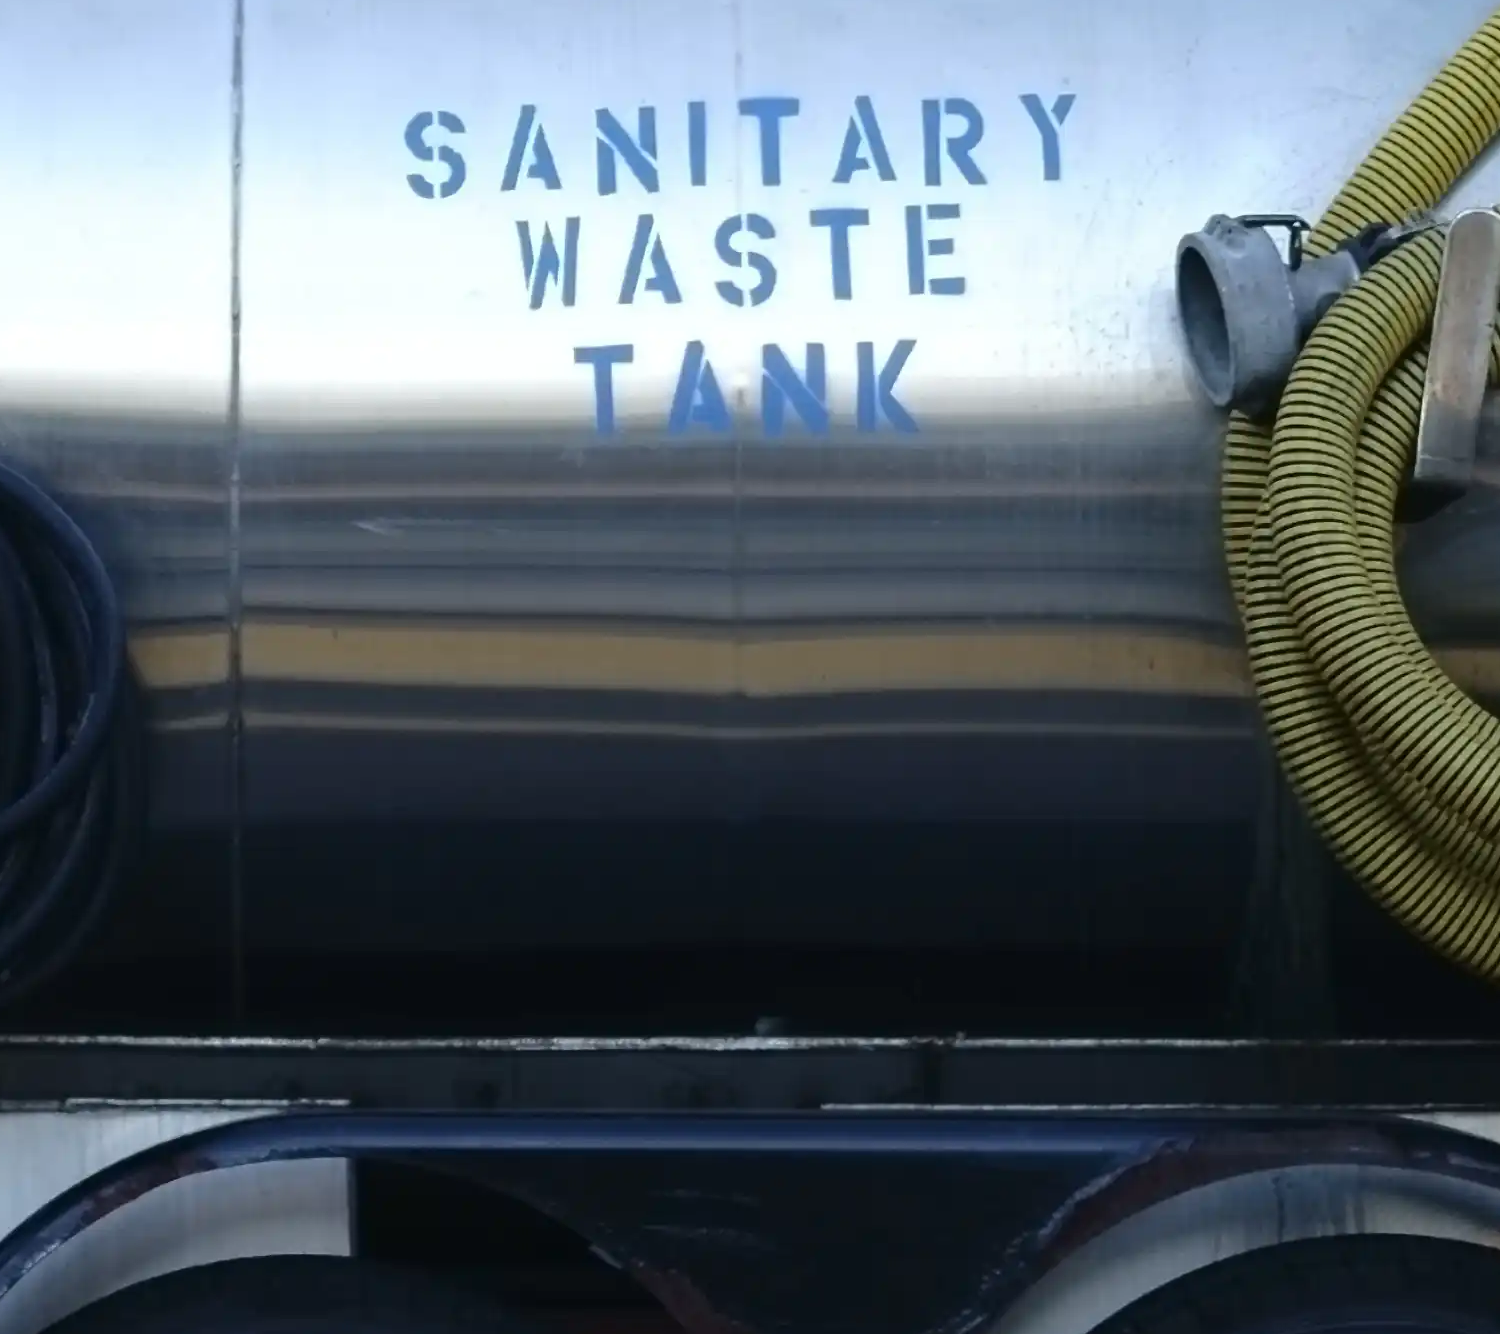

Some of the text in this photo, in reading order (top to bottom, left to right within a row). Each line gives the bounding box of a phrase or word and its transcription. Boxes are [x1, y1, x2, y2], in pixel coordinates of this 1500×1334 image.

[404, 93, 1077, 199] SANITARY
[516, 204, 966, 310] WASTE
[574, 339, 919, 437] TANK
